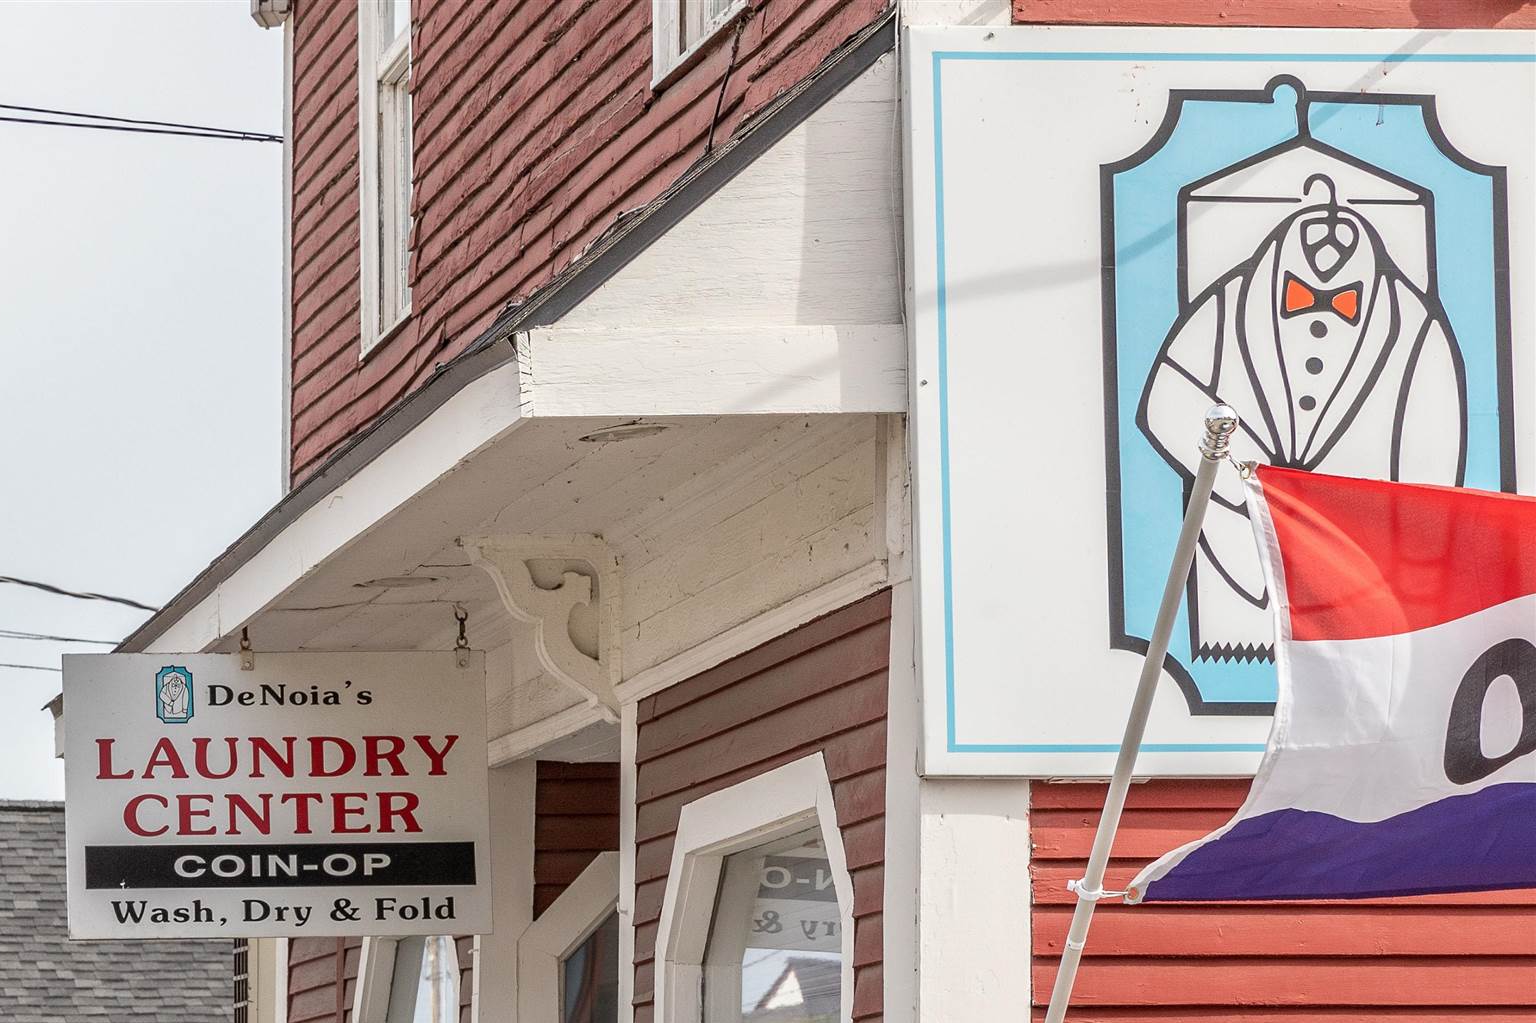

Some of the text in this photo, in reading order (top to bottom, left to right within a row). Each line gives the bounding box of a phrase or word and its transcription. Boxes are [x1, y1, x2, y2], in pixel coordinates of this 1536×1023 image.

[207, 680, 373, 707] DeNoia's
[95, 734, 460, 780] LAUNDRY
[123, 792, 423, 837] CENTER
[173, 853, 392, 878] COIN-OP
[111, 897, 457, 927] Wash, Dry & Fold
